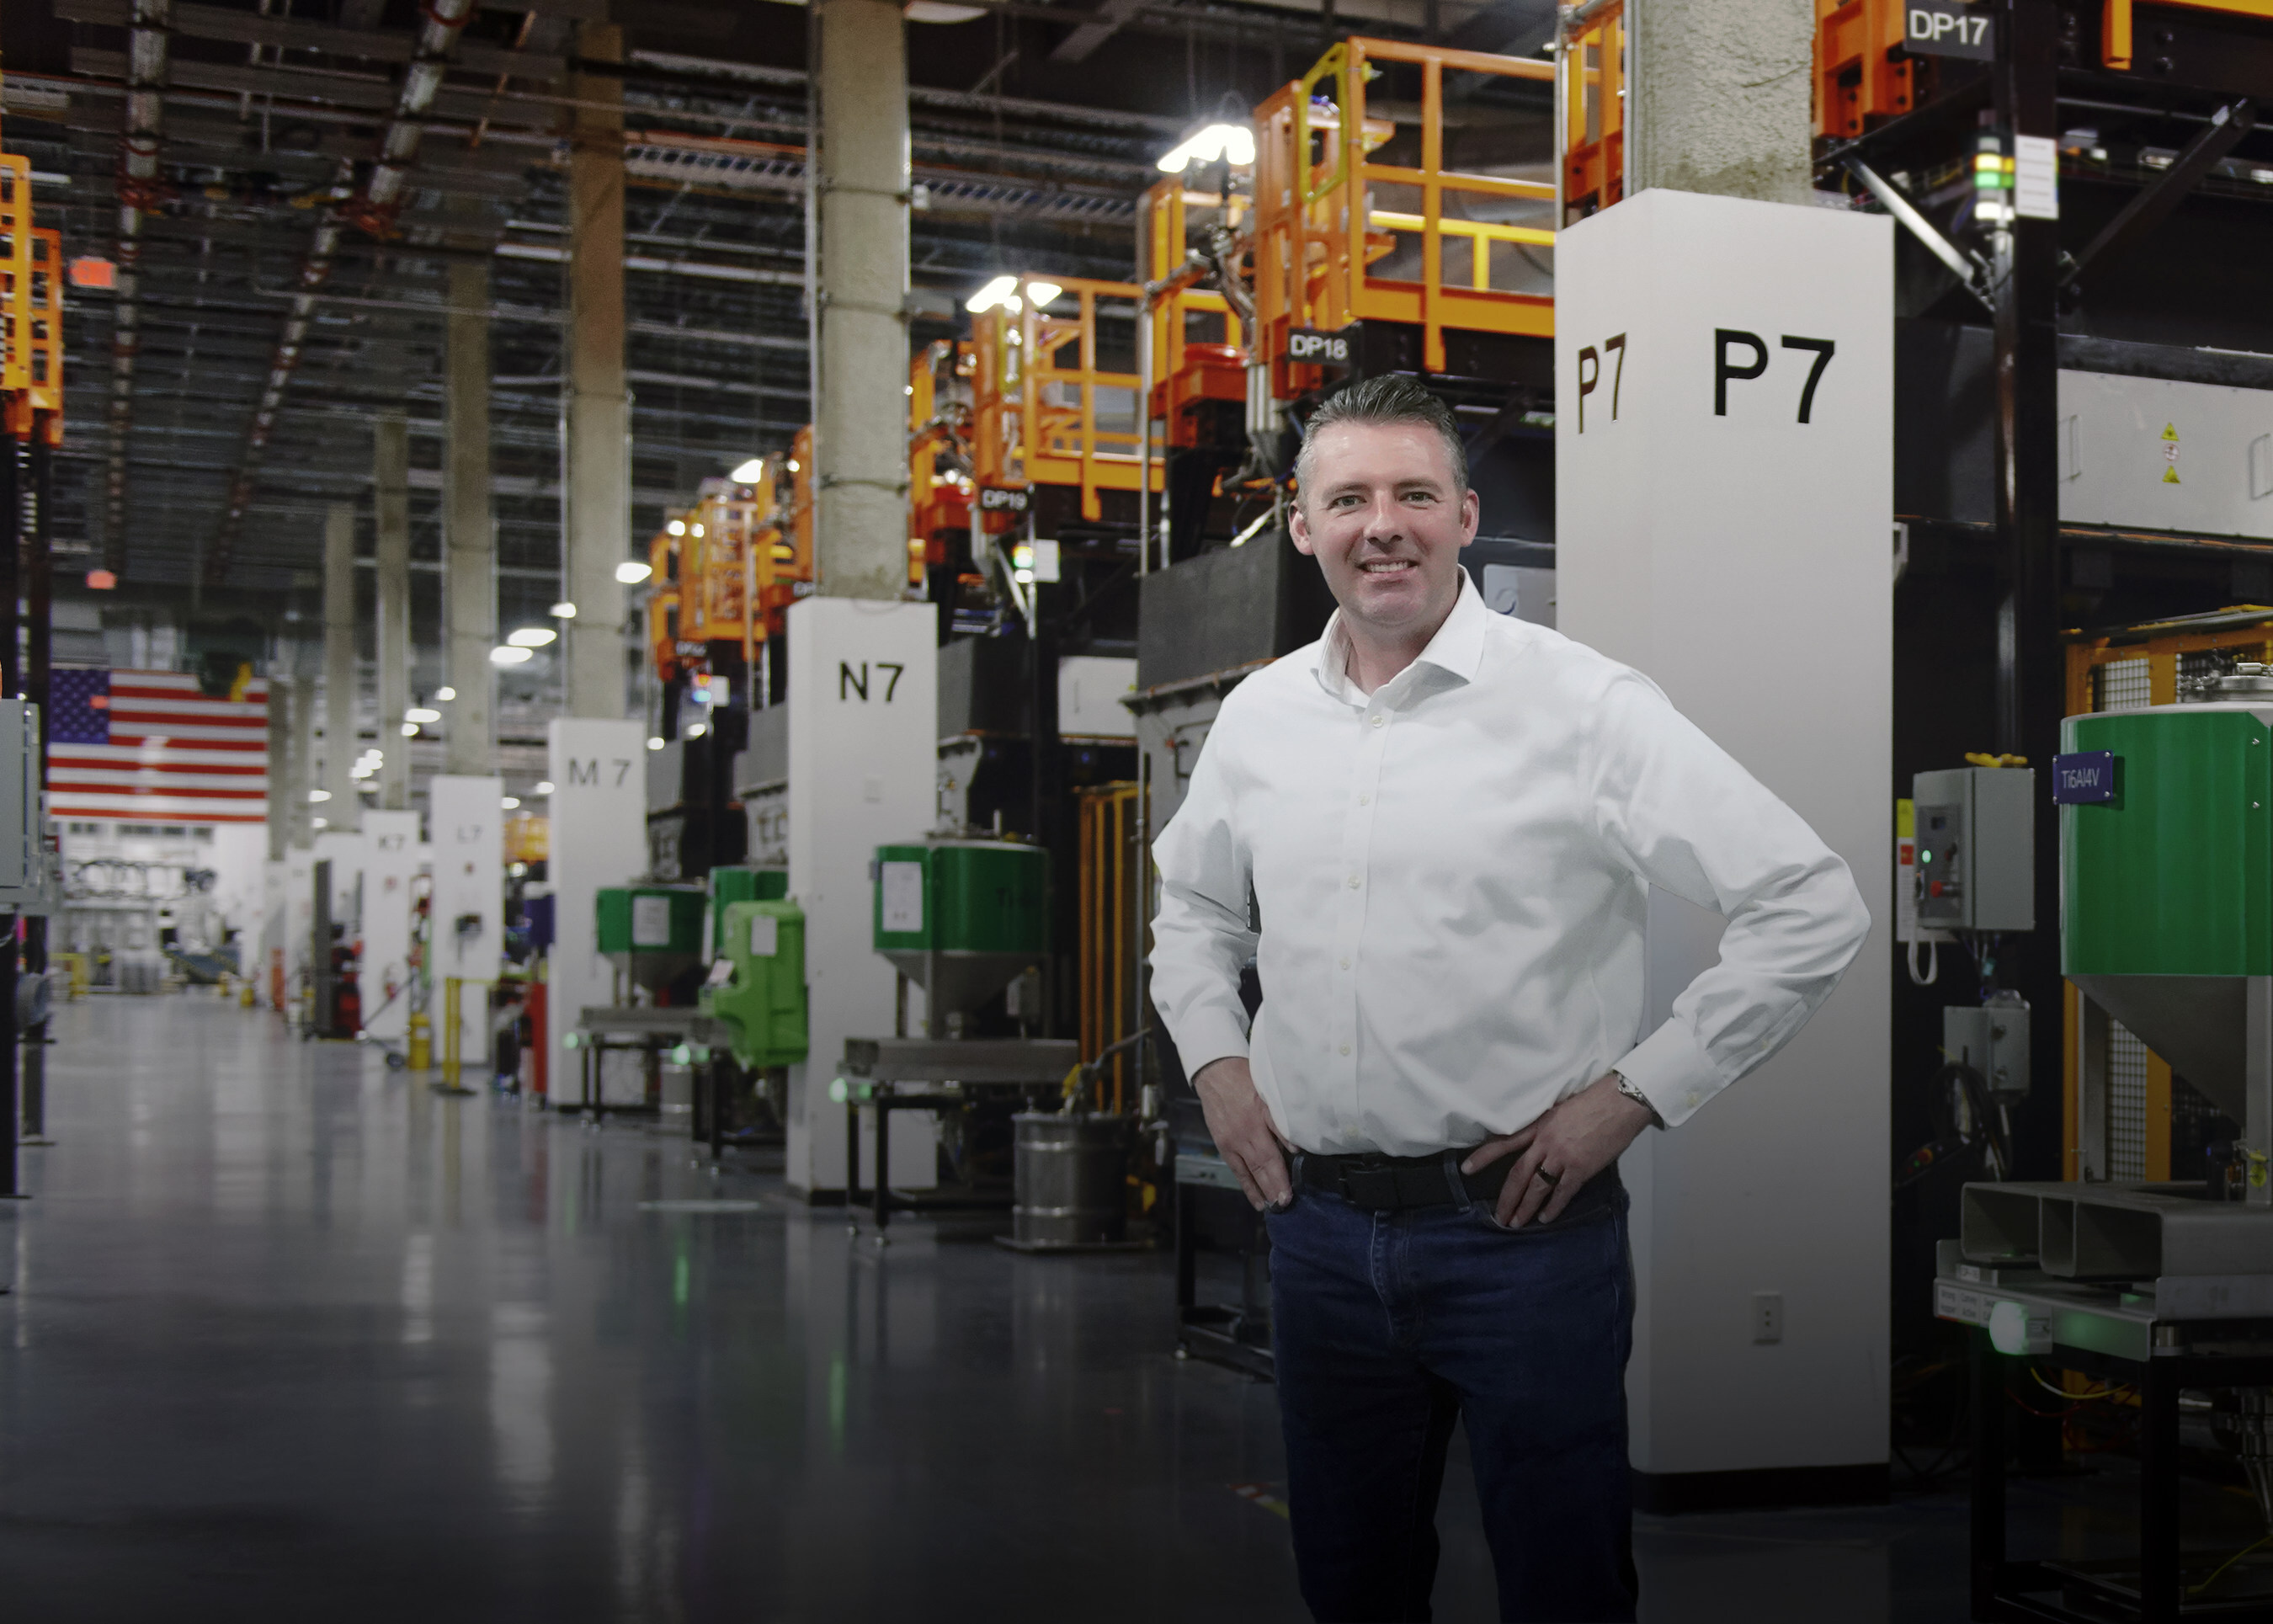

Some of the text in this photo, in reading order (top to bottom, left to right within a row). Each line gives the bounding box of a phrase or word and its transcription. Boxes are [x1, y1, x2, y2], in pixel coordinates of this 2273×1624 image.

[1908, 8, 1989, 47] DP17
[1290, 333, 1349, 361] DP18
[1578, 332, 1627, 434] P7
[1714, 327, 1835, 424] P7
[839, 661, 905, 703] N7
